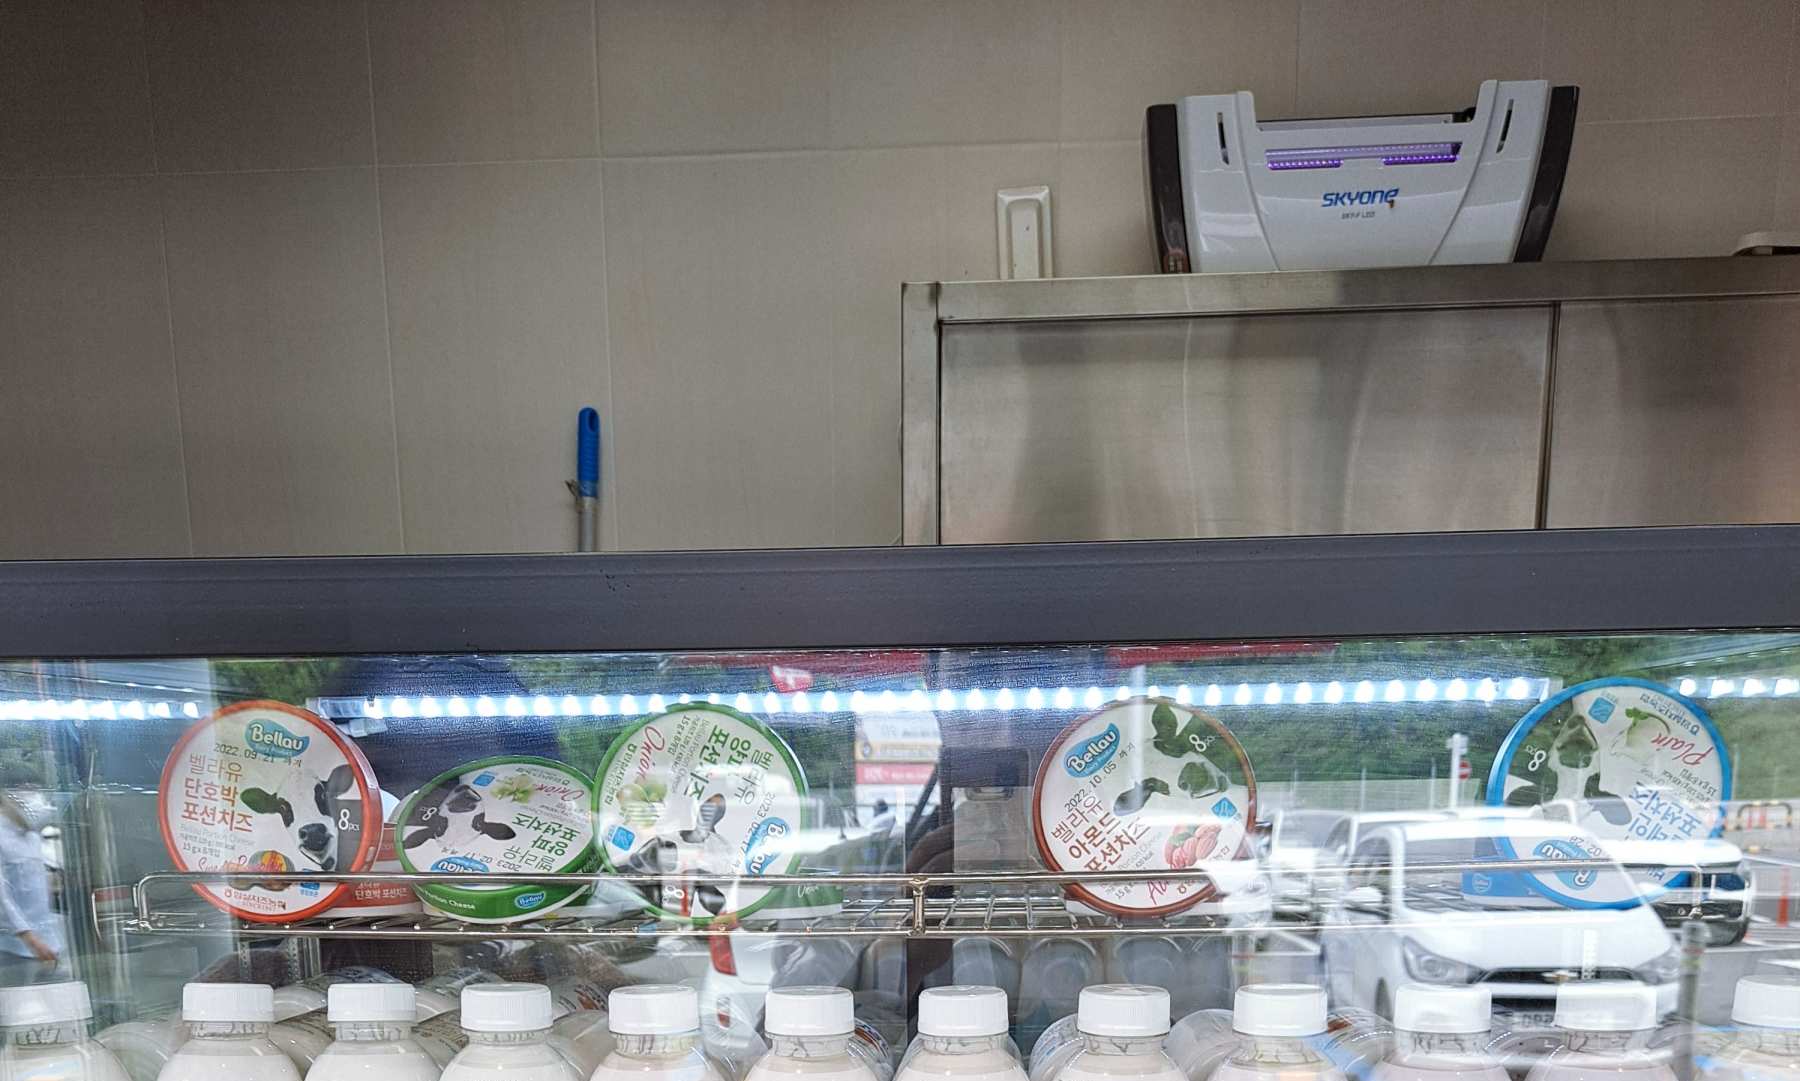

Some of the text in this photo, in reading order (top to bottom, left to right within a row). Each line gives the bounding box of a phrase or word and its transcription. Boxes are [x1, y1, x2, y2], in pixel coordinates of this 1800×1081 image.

[251, 724, 302, 749] Bellau
[1651, 732, 1714, 766] Plain
[1067, 730, 1117, 773] Bellau
[190, 754, 242, 781] 벨라유
[184, 778, 238, 806] 단호박
[536, 784, 584, 801] Onion
[1064, 761, 1117, 812] 2022.10.05
[182, 802, 253, 832] 포션치즈
[512, 813, 580, 841] 포션치즈
[1051, 795, 1103, 843] 벨라유
[532, 835, 569, 856] 양파
[1069, 811, 1121, 860] 아몬드
[1084, 817, 1151, 871] 포션치즈
[503, 846, 555, 872] 벨라유
